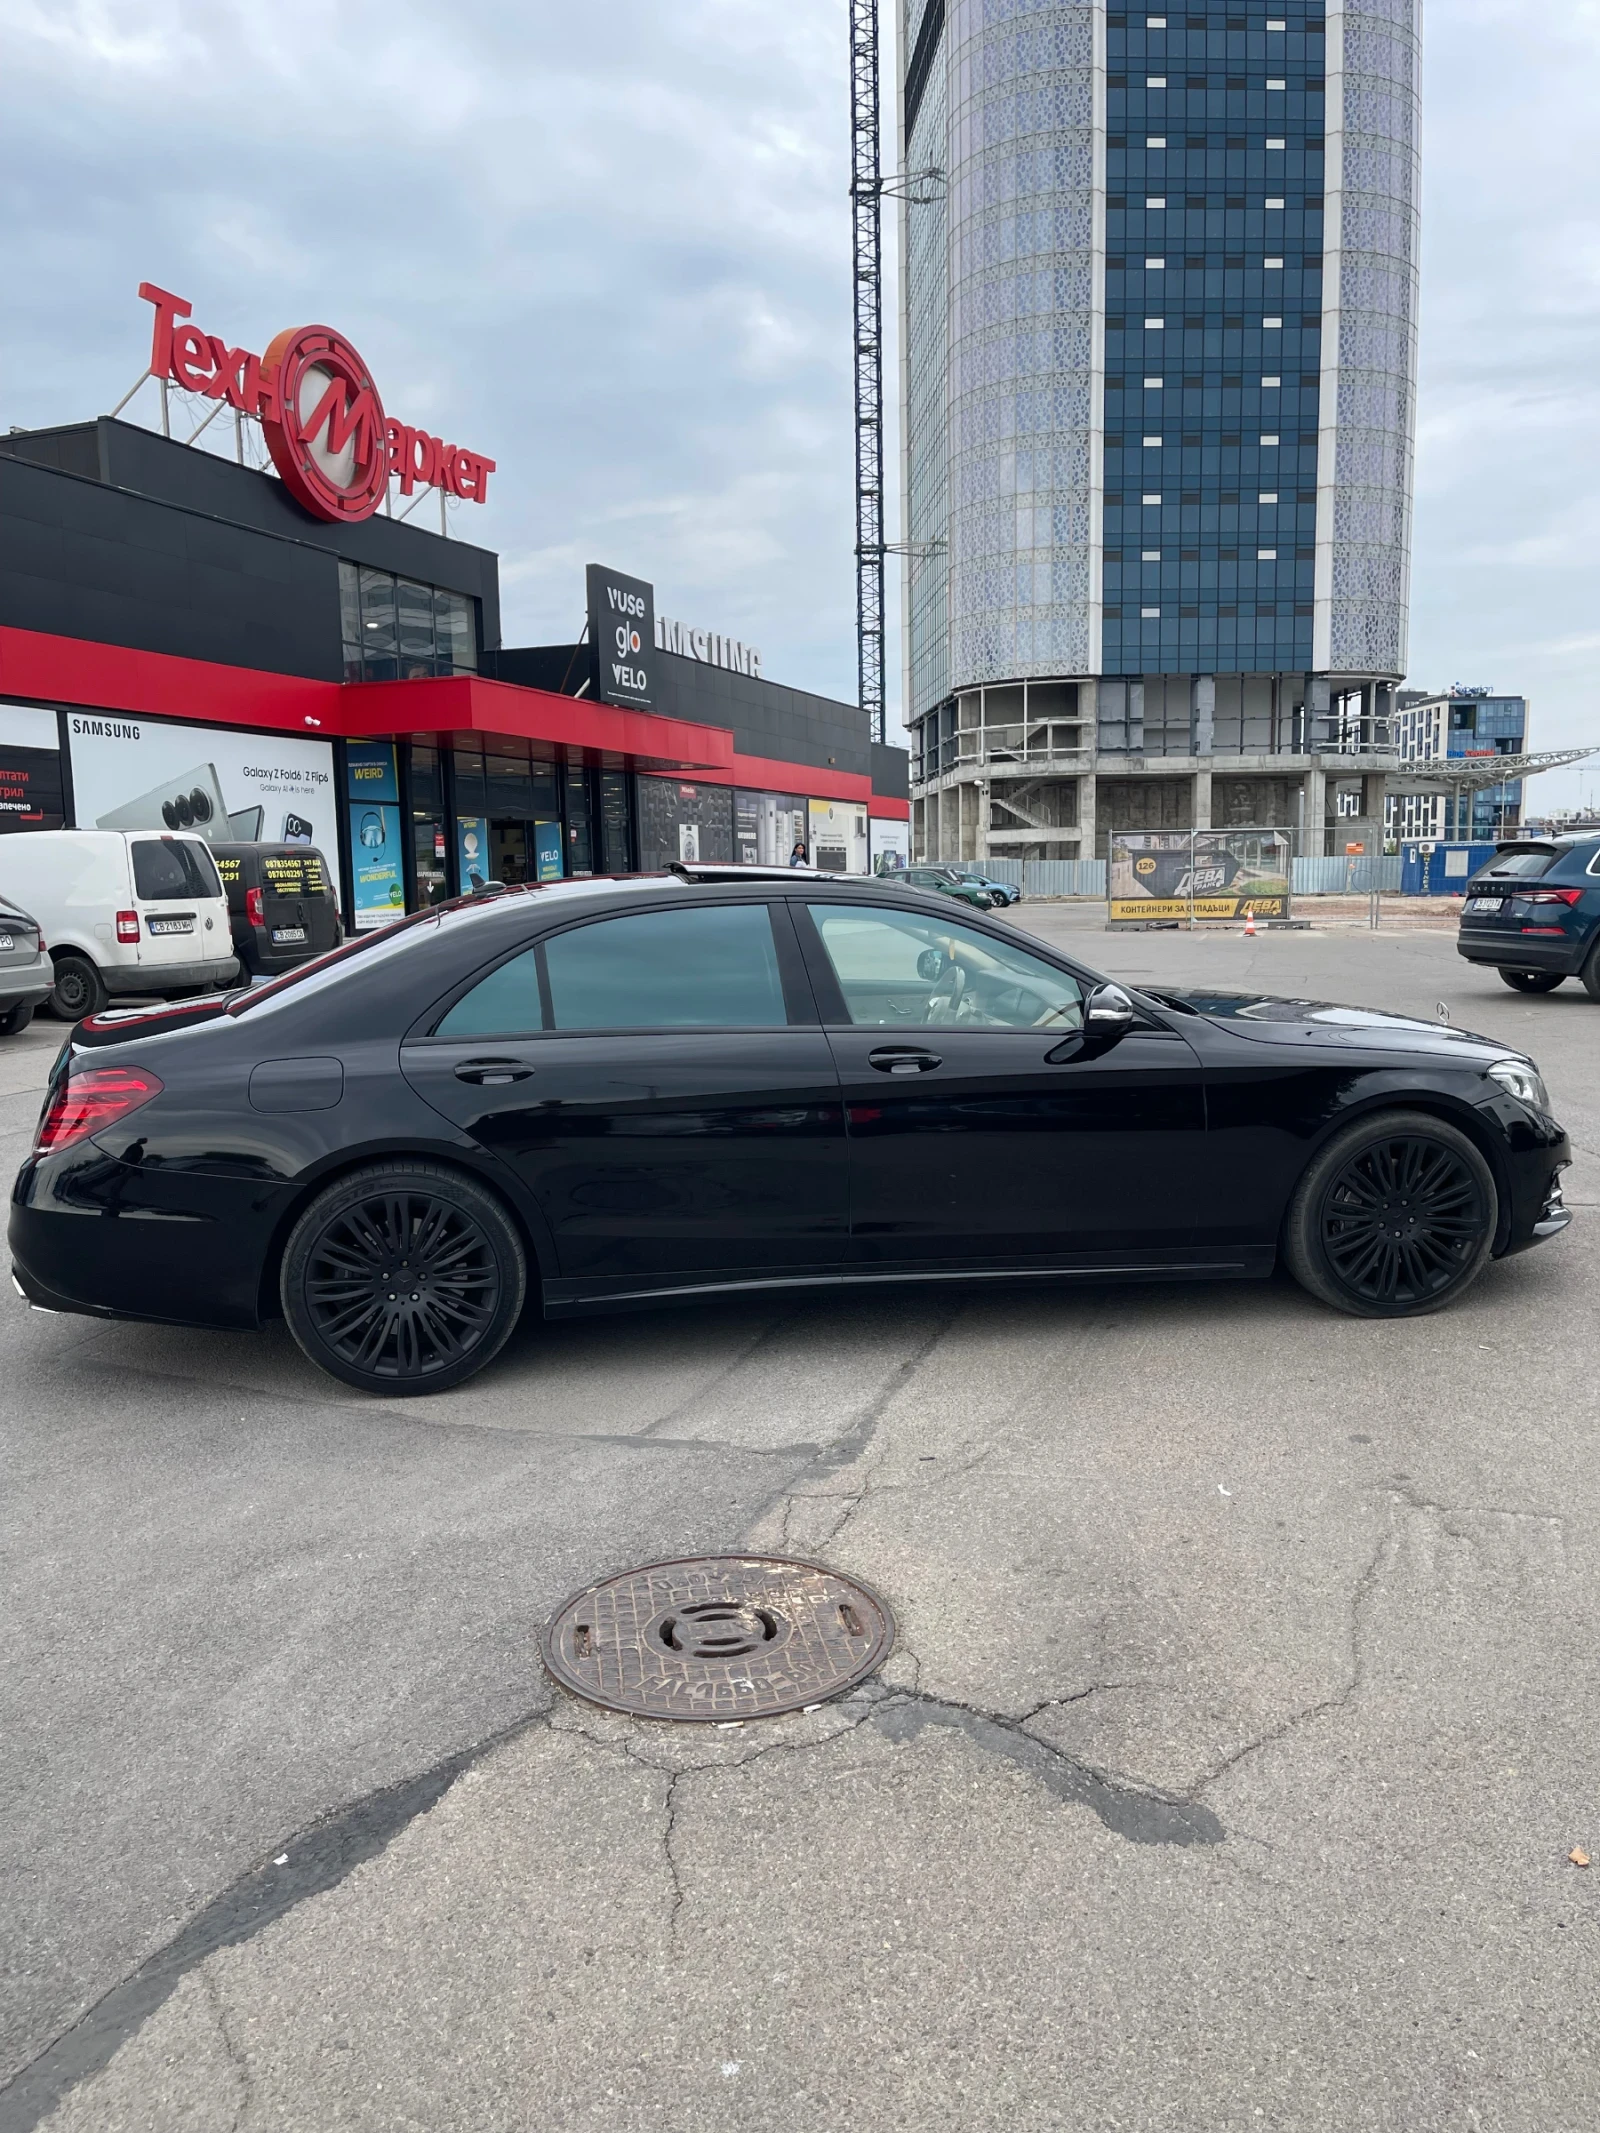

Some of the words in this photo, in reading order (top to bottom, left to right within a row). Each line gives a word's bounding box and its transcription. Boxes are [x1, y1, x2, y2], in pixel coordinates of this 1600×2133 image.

[615, 621, 641, 659] glo
[612, 663, 647, 691] VELO
[73, 719, 141, 741] SAMSUNG
[243, 766, 273, 780] Galaxy
[274, 768, 279, 779] Z
[280, 769, 302, 780] Fold6
[305, 771, 310, 781] Z
[311, 771, 329, 785] Flip6
[354, 768, 384, 780] WEIRD
[260, 783, 281, 794] Galaxy
[301, 786, 315, 794] here
[540, 850, 559, 862] VELO
[359, 870, 397, 884] WONDERFUL
[390, 890, 402, 898] VELO
[1121, 904, 1173, 914] КОНТЕЙНЕРИ
[1174, 904, 1185, 913] ЗА
[1187, 904, 1231, 914] ОТПАДЪЦИ
